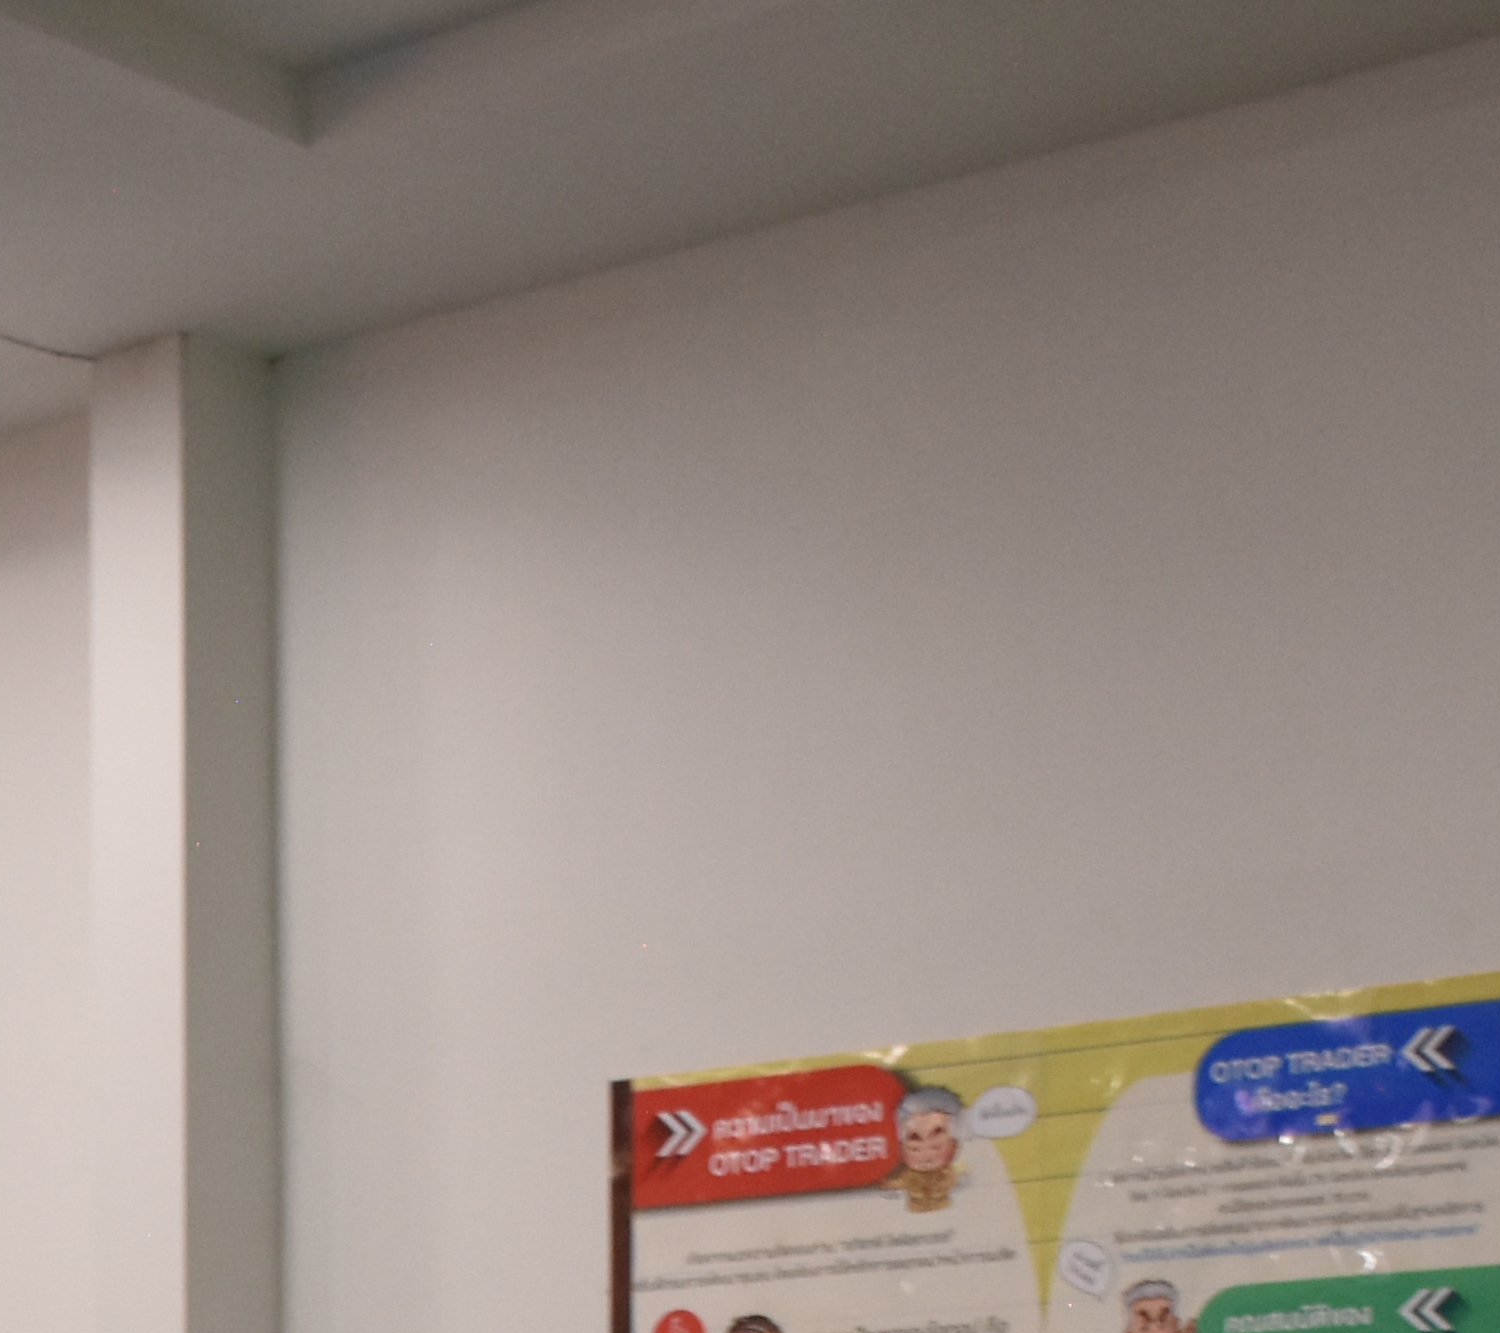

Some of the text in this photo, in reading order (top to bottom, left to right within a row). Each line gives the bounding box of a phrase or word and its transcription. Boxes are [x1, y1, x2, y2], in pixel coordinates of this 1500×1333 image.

[1210, 1043, 1393, 1083] OTOP TRADER
[707, 1136, 888, 1177] OTOP TRADER
